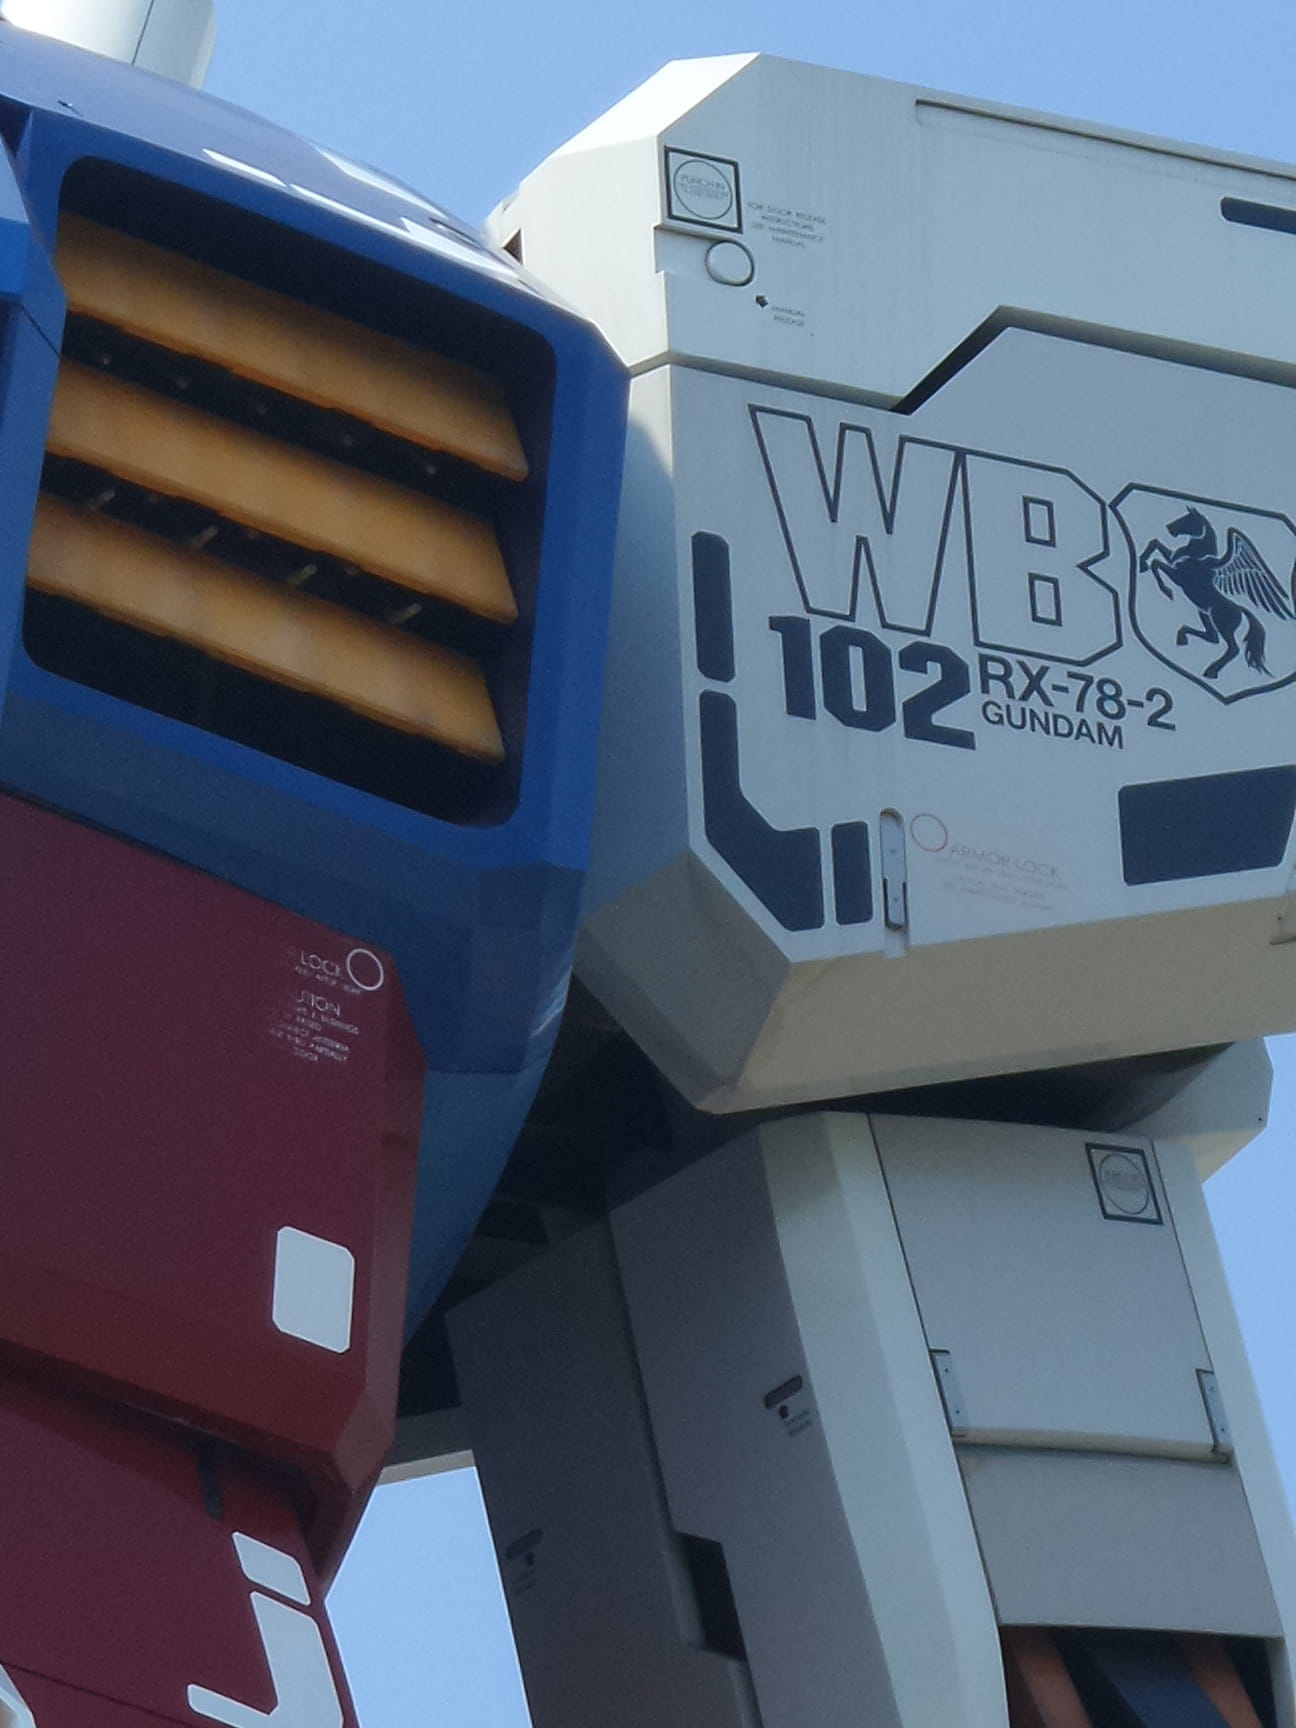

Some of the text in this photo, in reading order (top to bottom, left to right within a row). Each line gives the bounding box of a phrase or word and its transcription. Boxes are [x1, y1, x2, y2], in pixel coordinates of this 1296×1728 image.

[747, 403, 1124, 667] WB
[768, 615, 976, 750] 102
[978, 652, 1176, 731] RX-78-2
[982, 700, 1124, 749] GUNDAM
